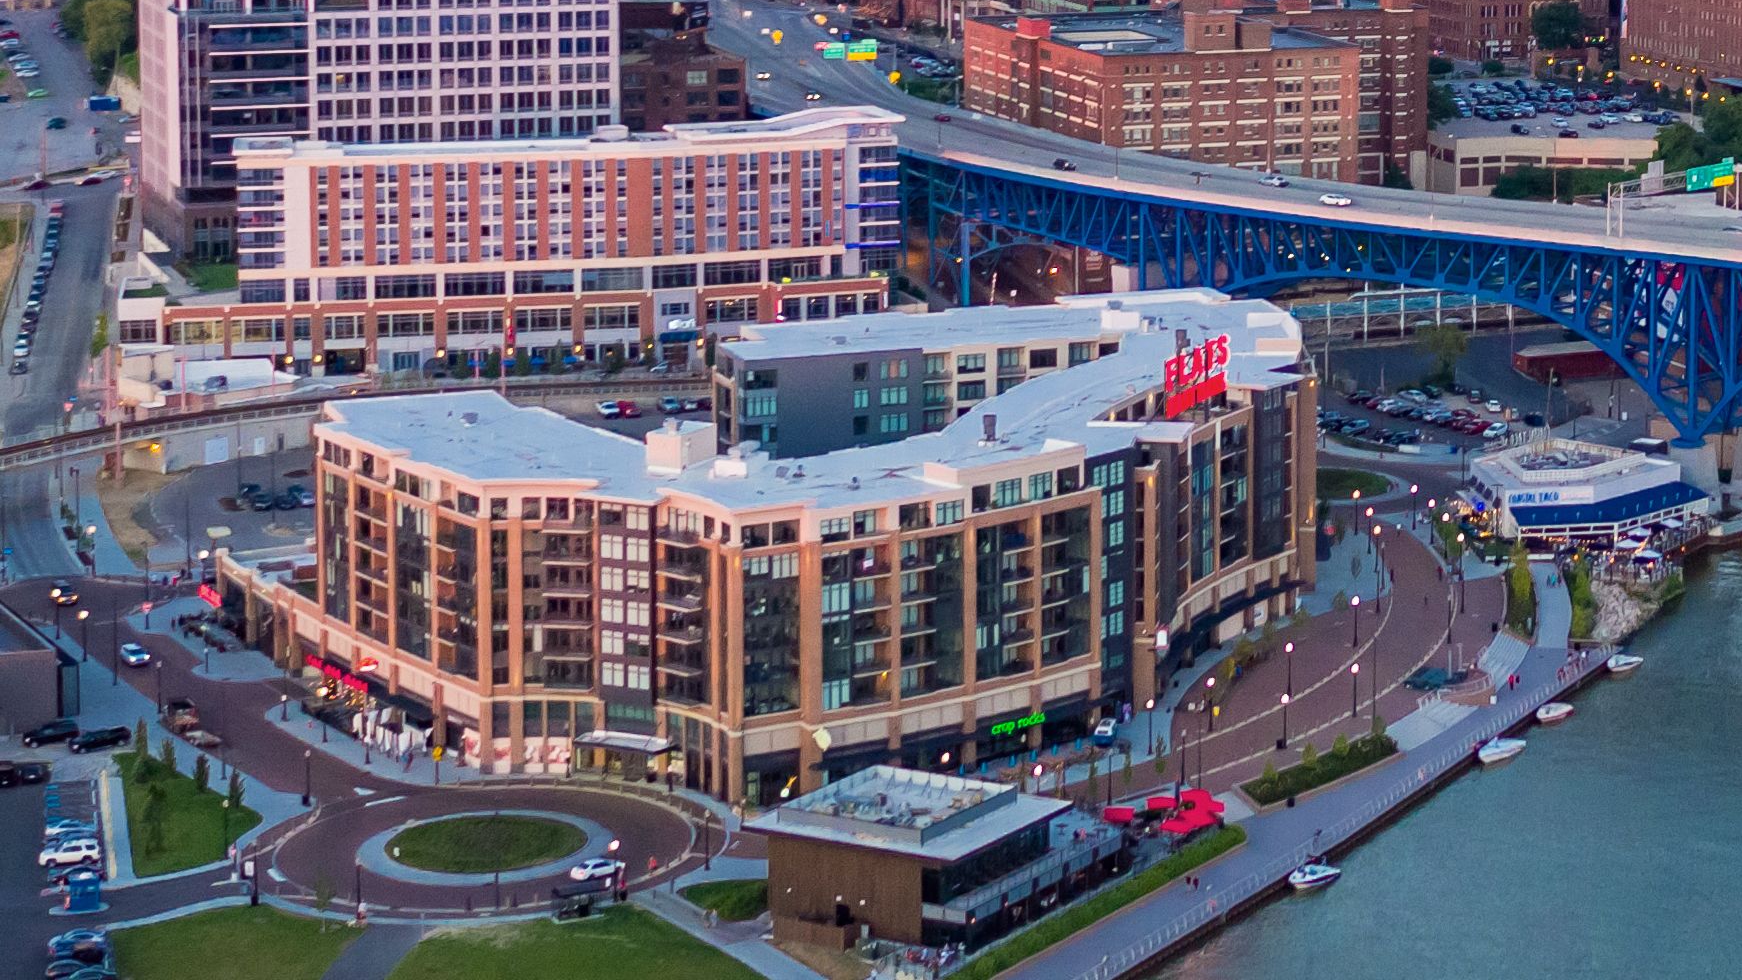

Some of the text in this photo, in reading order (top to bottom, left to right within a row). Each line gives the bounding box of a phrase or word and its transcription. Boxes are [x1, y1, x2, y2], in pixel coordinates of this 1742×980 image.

[1164, 333, 1231, 394] FLATS
[991, 711, 1046, 736] crop rocks
